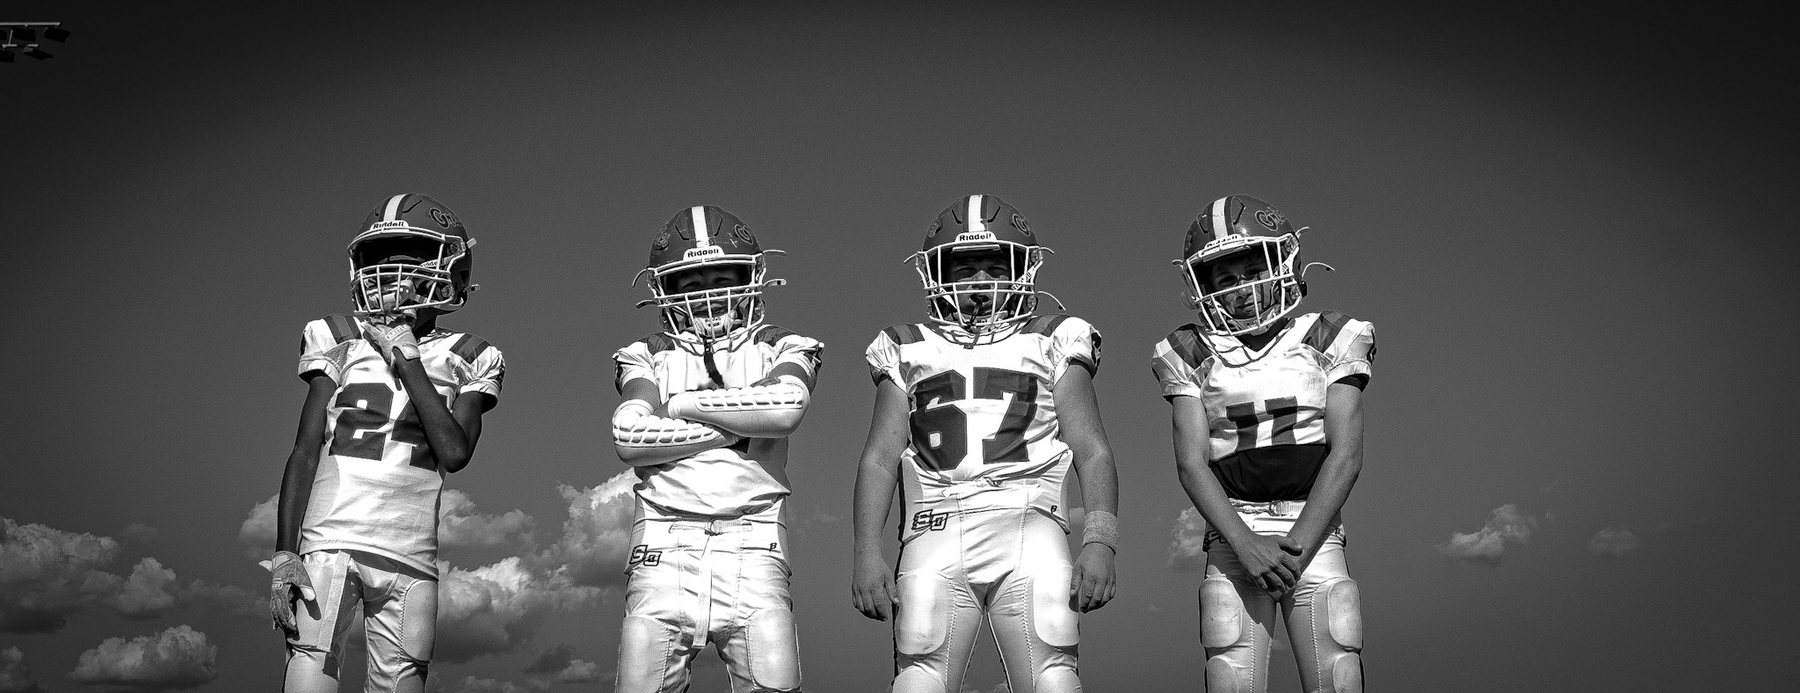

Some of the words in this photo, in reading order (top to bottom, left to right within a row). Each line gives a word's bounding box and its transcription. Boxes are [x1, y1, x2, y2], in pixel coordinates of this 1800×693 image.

[959, 232, 992, 242] Riddell
[687, 248, 720, 258] Riddell
[909, 366, 1039, 472] 67
